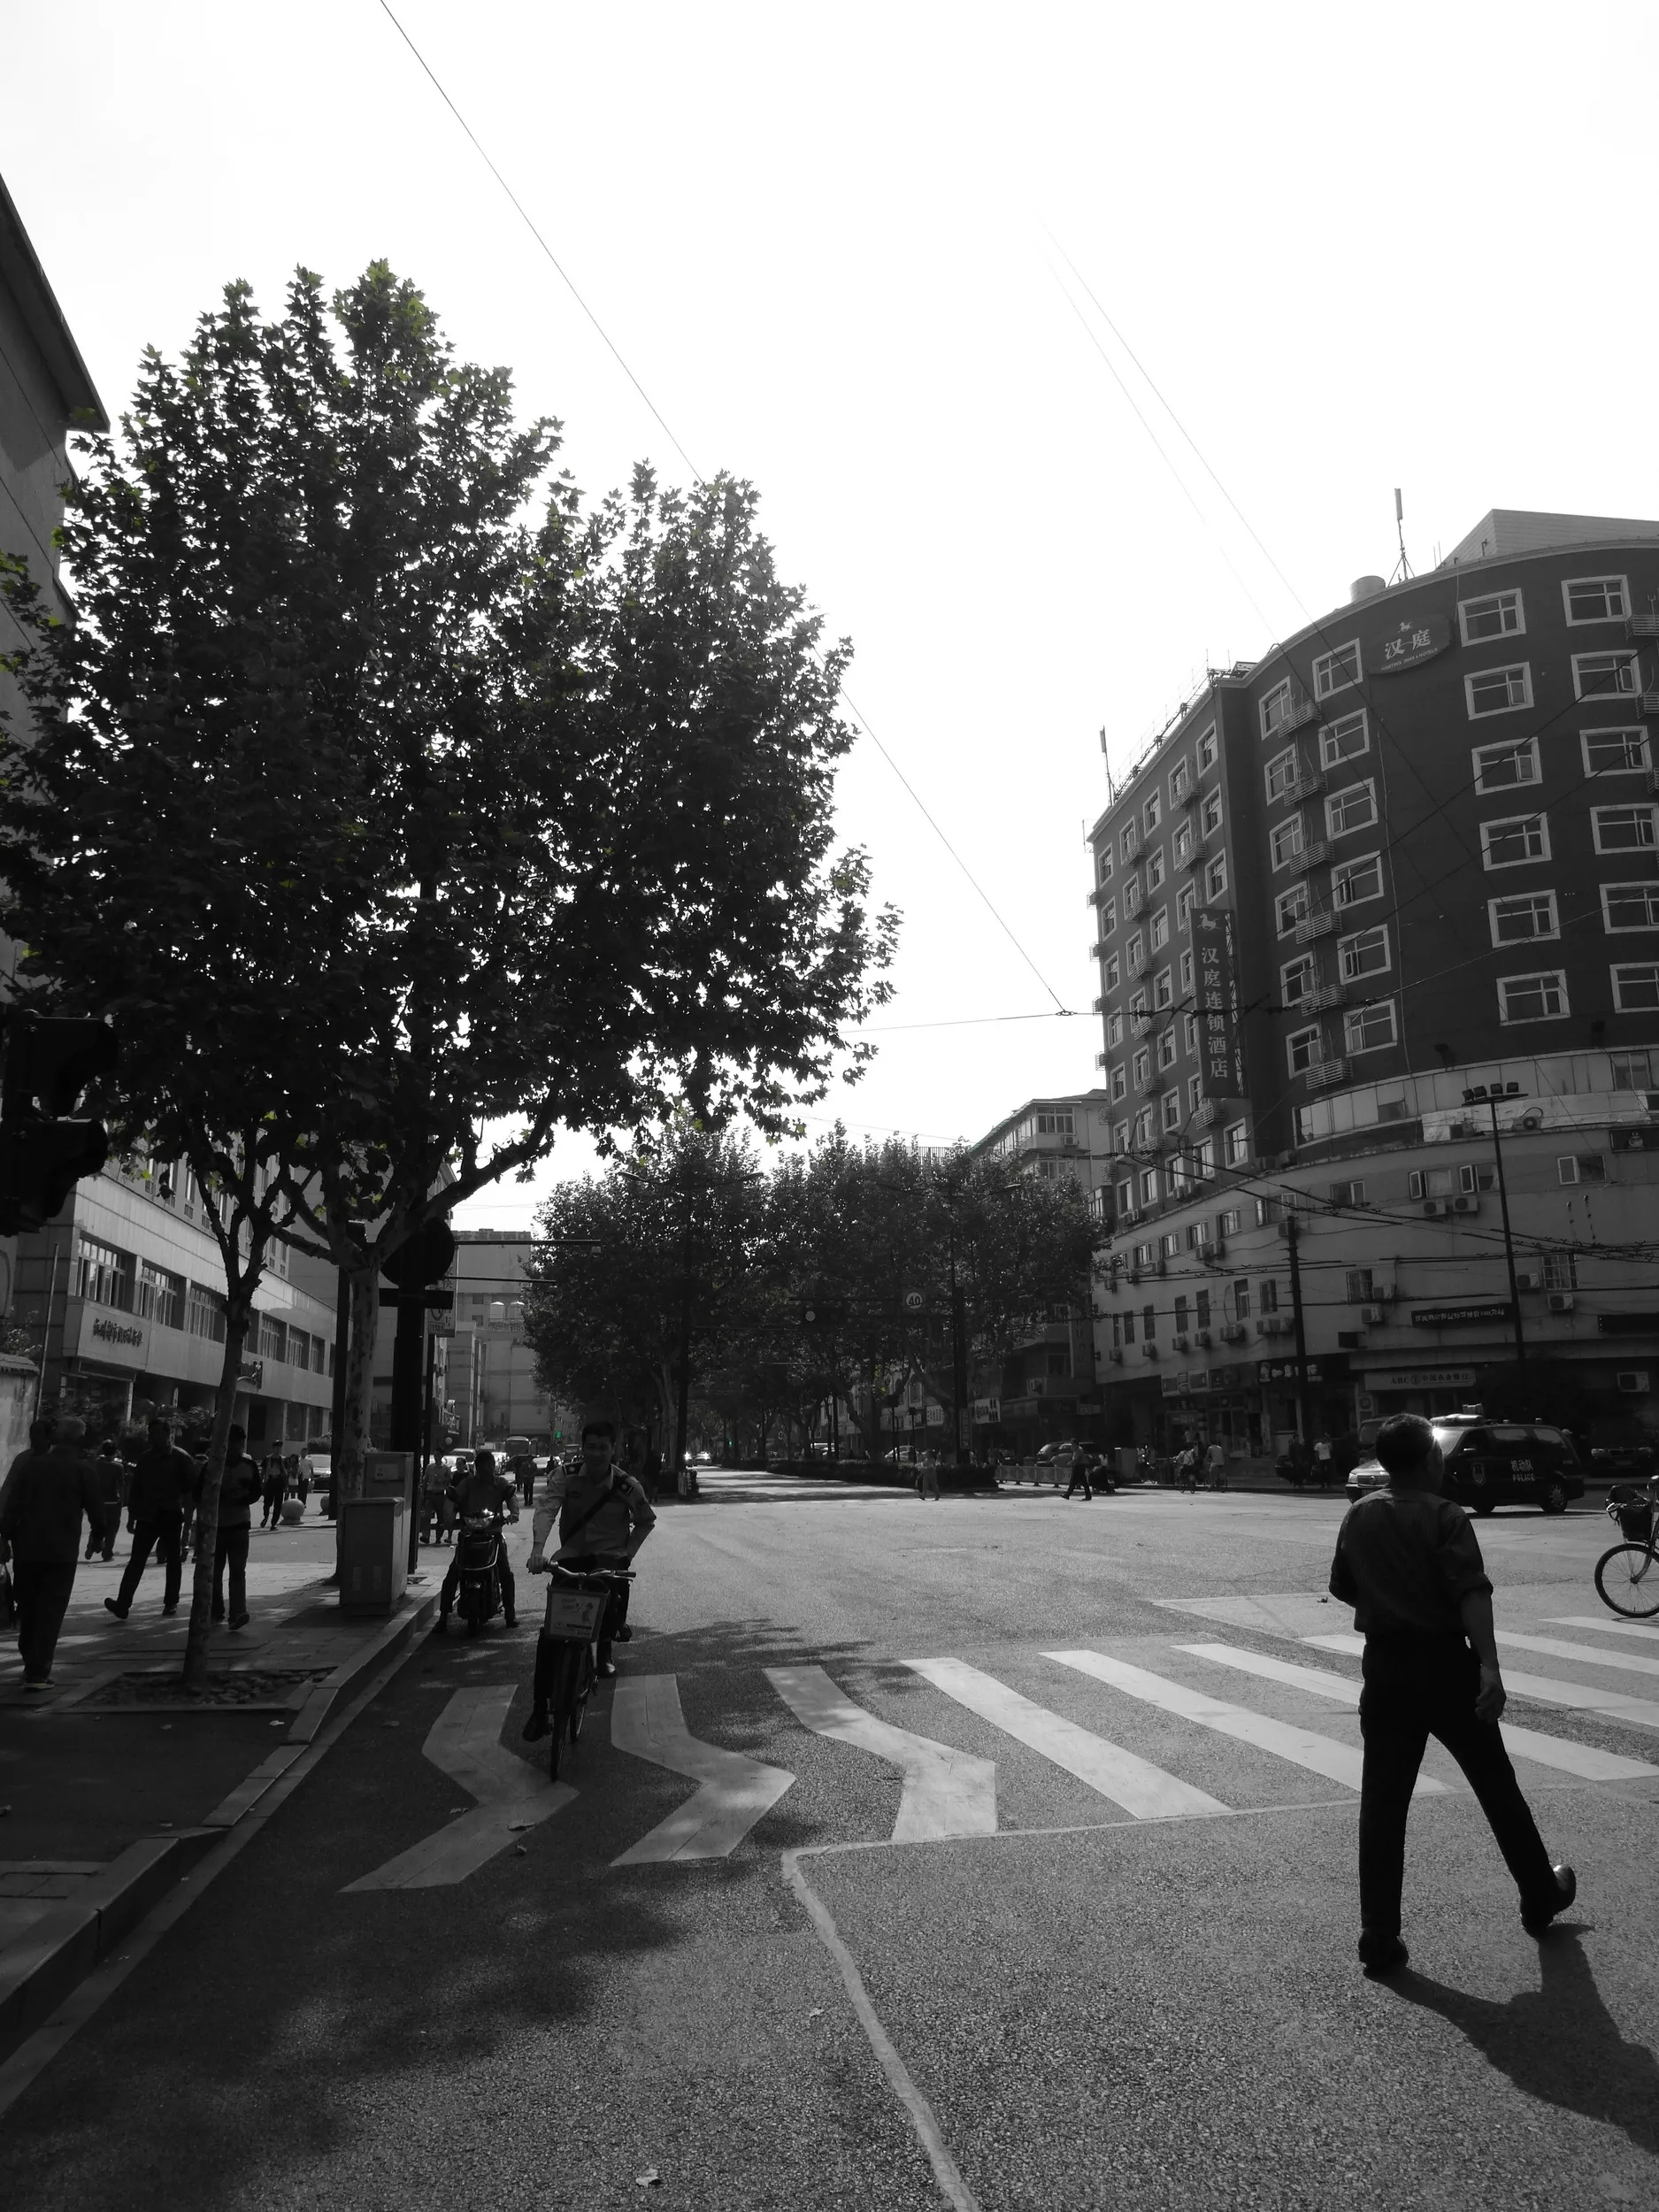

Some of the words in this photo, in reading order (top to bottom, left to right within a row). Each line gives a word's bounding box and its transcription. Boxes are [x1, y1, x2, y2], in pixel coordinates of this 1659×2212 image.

[1384, 628, 1431, 660] 汉庭
[1202, 947, 1229, 1079] 汉庭连锁酒店
[909, 1295, 920, 1306] 40
[1391, 1376, 1409, 1385] ABC
[1512, 1473, 1535, 1483] POLICE
